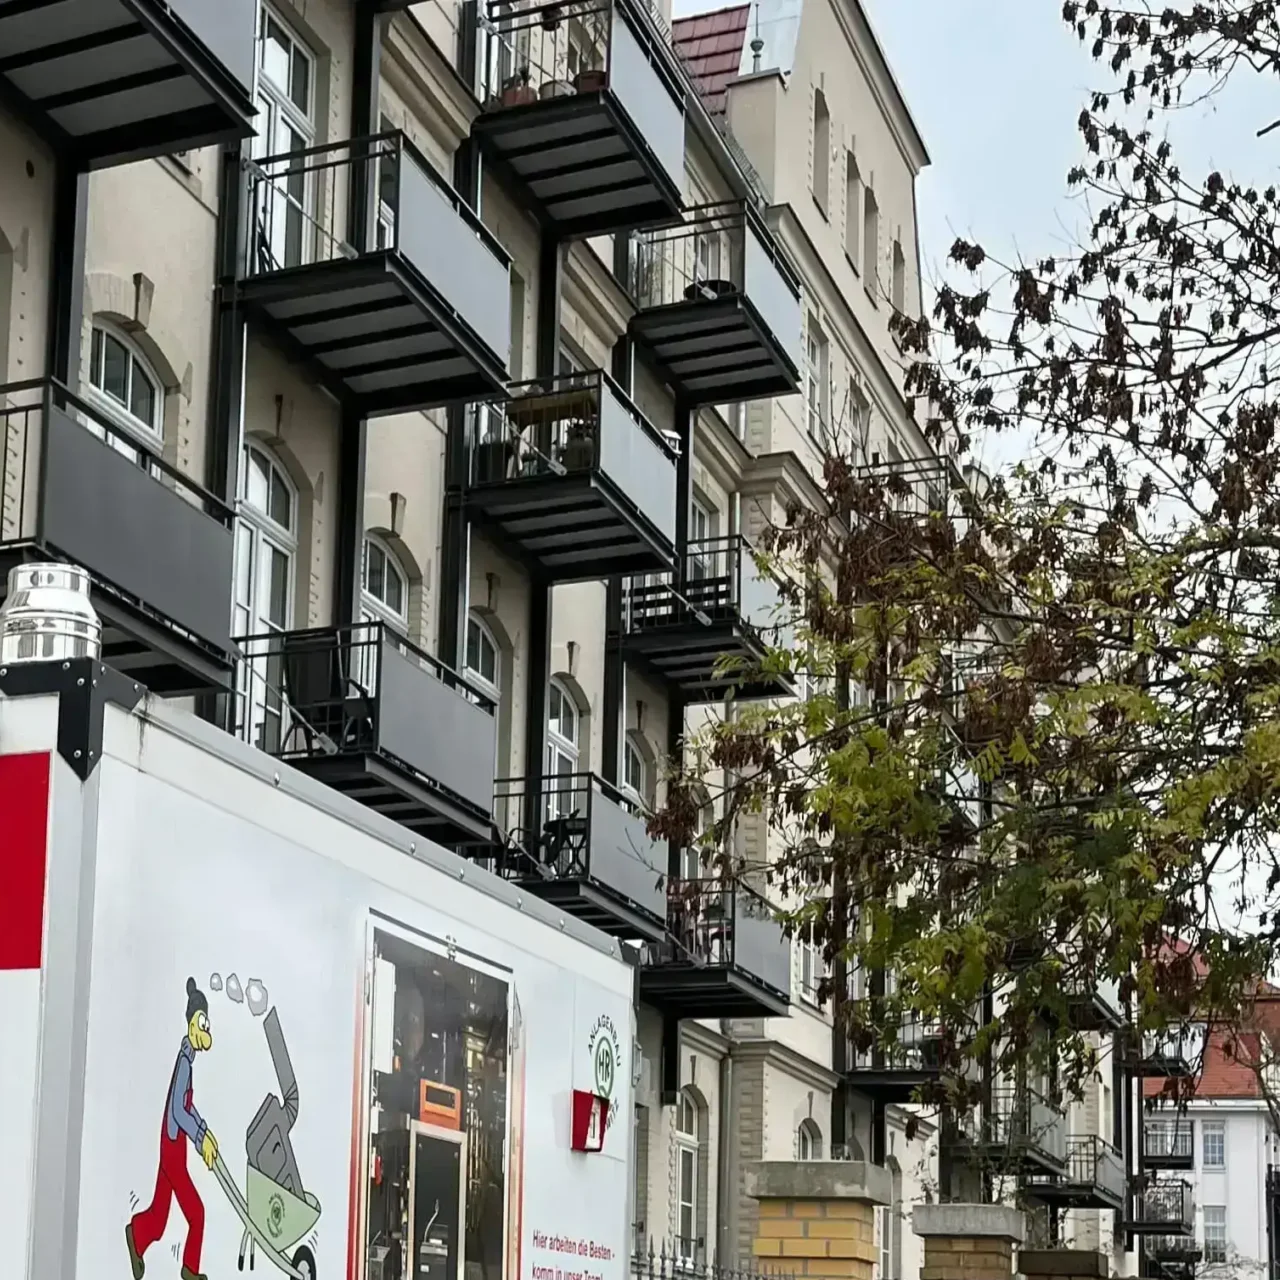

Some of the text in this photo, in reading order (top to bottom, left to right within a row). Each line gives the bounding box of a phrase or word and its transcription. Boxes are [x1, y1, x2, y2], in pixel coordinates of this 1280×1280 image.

[587, 1013, 621, 1067] ANLAGENBAU
[532, 1229, 547, 1249] Hier
[549, 1233, 577, 1254] arbeiten
[578, 1239, 588, 1256] die
[589, 1240, 611, 1260] Besten
[532, 1262, 554, 1280] komm
